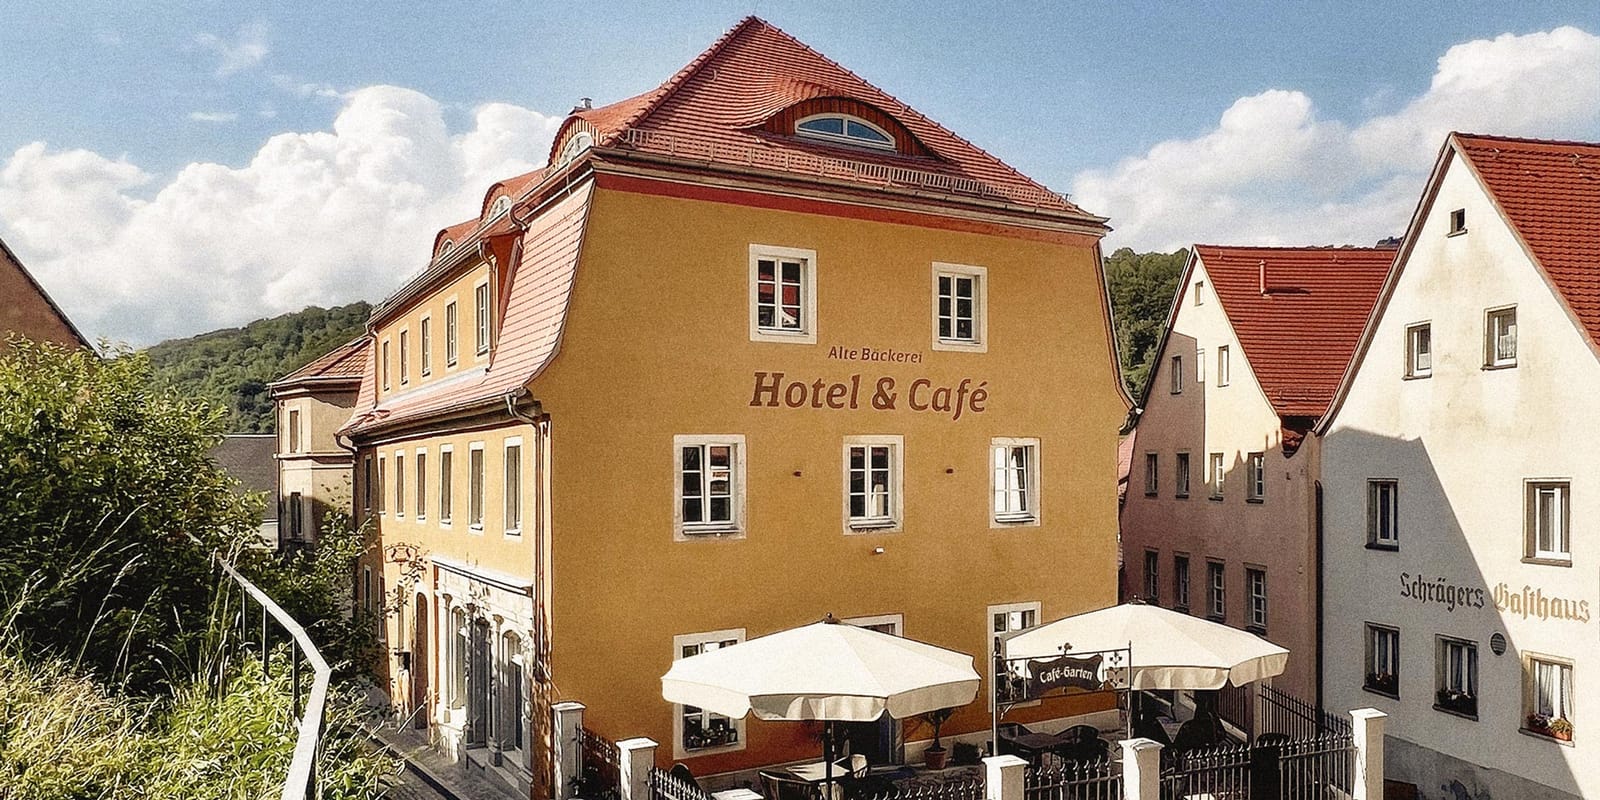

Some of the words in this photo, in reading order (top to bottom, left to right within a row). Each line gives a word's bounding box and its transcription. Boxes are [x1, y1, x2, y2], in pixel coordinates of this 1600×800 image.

[828, 346, 857, 361] Alte
[860, 347, 923, 364] Bäckerei
[750, 371, 861, 410] Hotel
[871, 376, 897, 410] &
[908, 378, 989, 421] Café
[1400, 571, 1486, 613] Schrägers
[1039, 665, 1093, 684] Café-Garten
